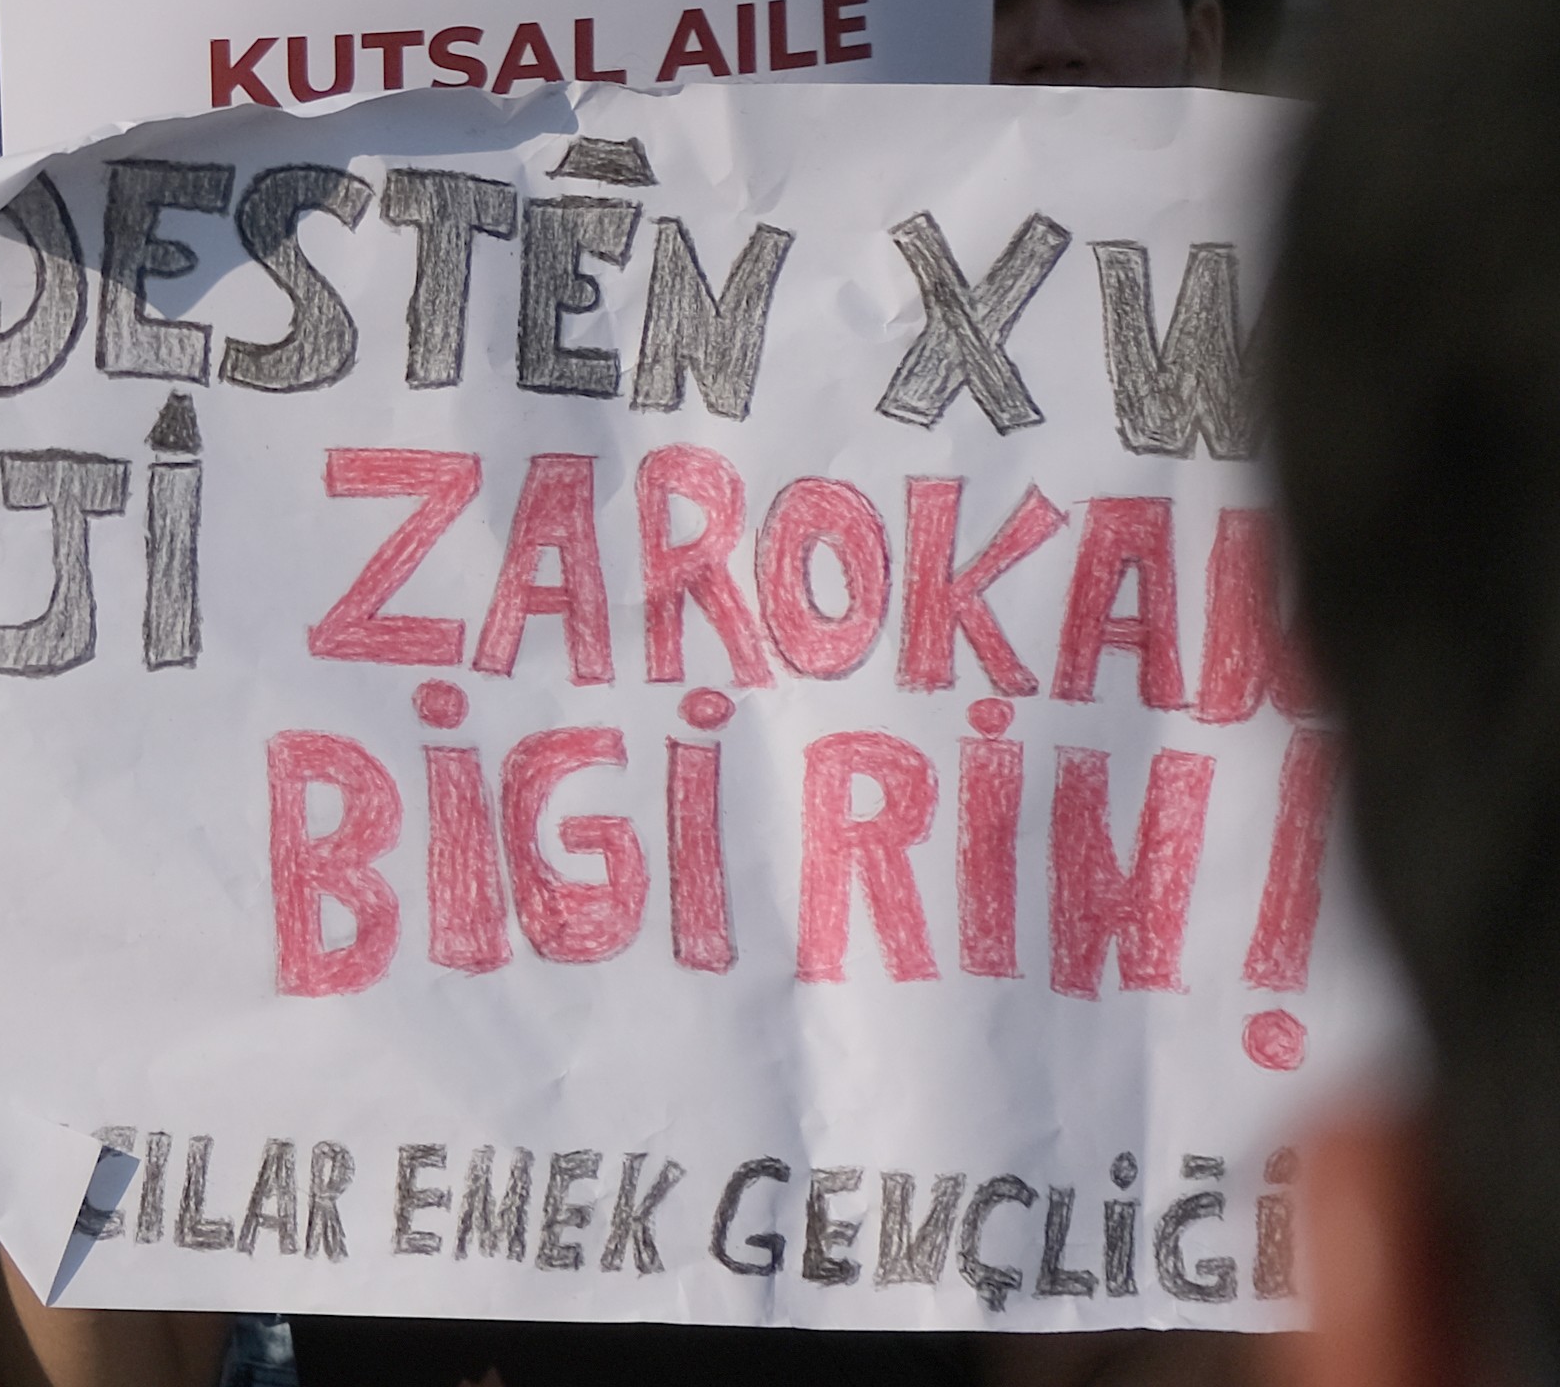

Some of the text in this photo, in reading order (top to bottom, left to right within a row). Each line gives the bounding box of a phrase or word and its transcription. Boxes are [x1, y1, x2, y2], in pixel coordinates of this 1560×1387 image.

[209, 20, 627, 108] KUTSAL
[389, 1139, 688, 1274] EMEK
[707, 1146, 1303, 1313] GENÇLİĞİ
